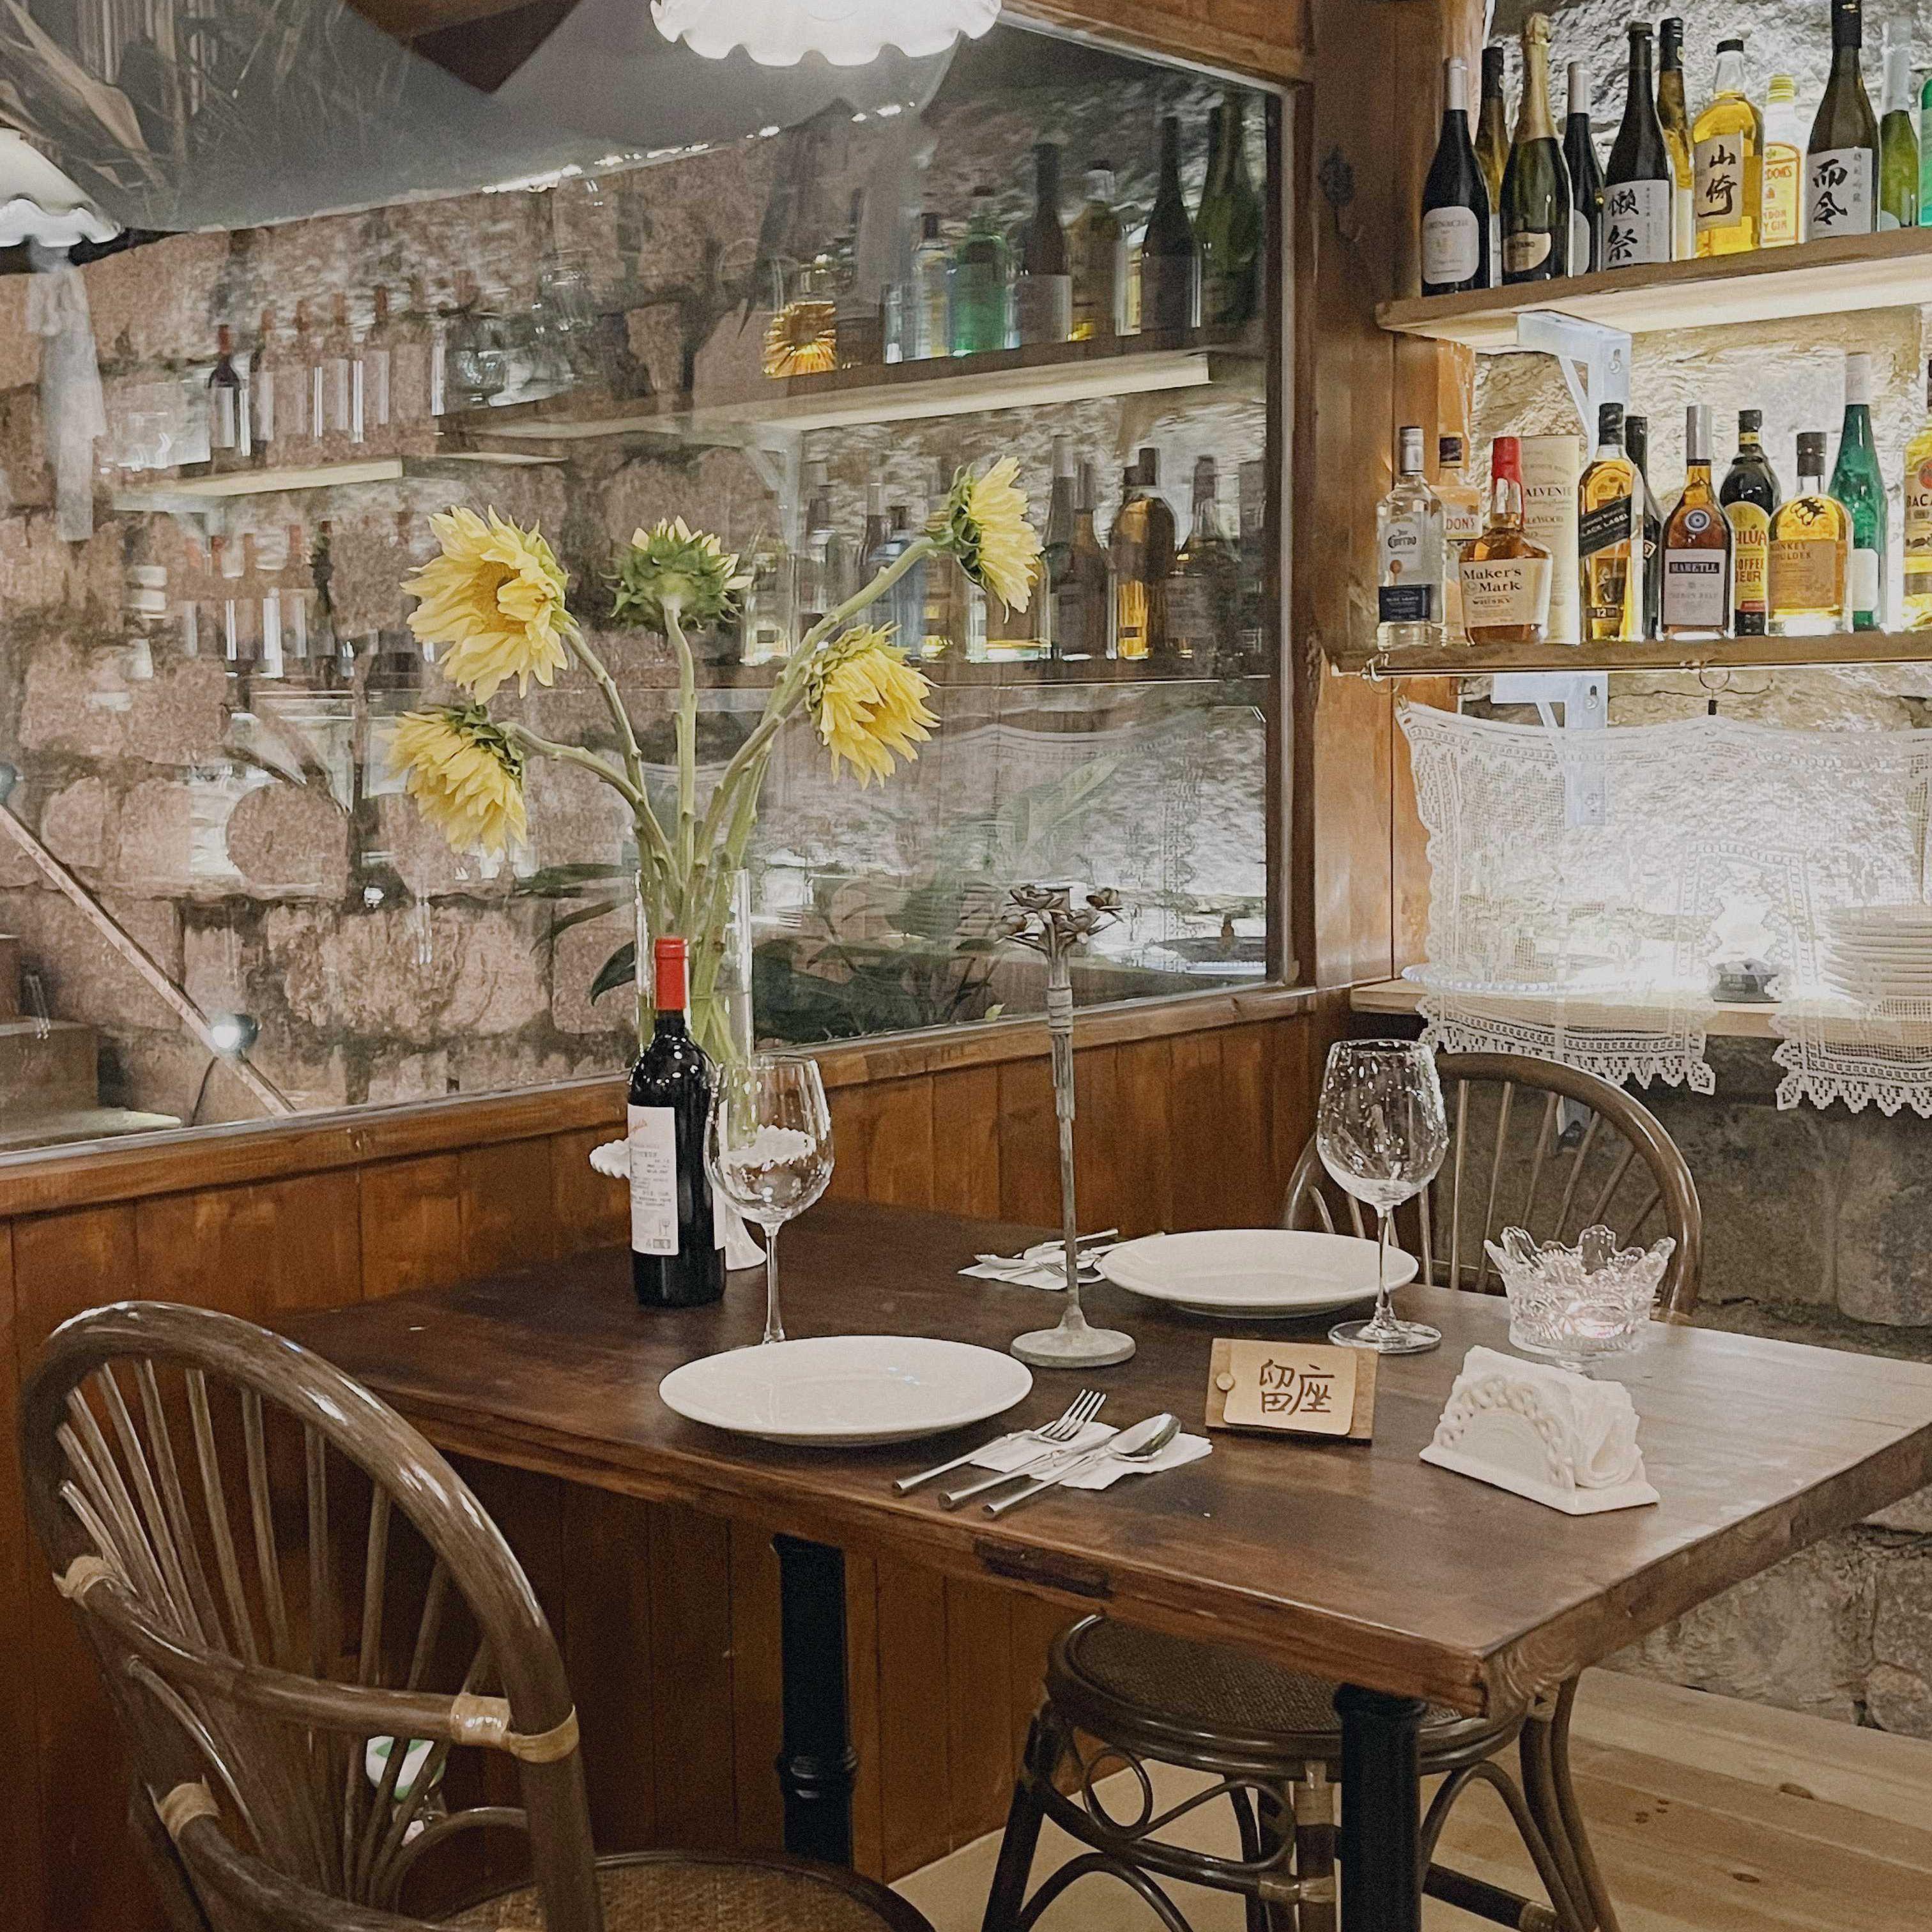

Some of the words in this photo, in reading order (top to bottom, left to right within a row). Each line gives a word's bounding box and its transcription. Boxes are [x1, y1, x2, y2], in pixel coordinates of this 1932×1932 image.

[1906, 494, 1932, 507] BAC
[1463, 567, 1522, 580] Maker's
[1479, 580, 1523, 593] Mark
[1259, 1358, 1335, 1416] 留座
